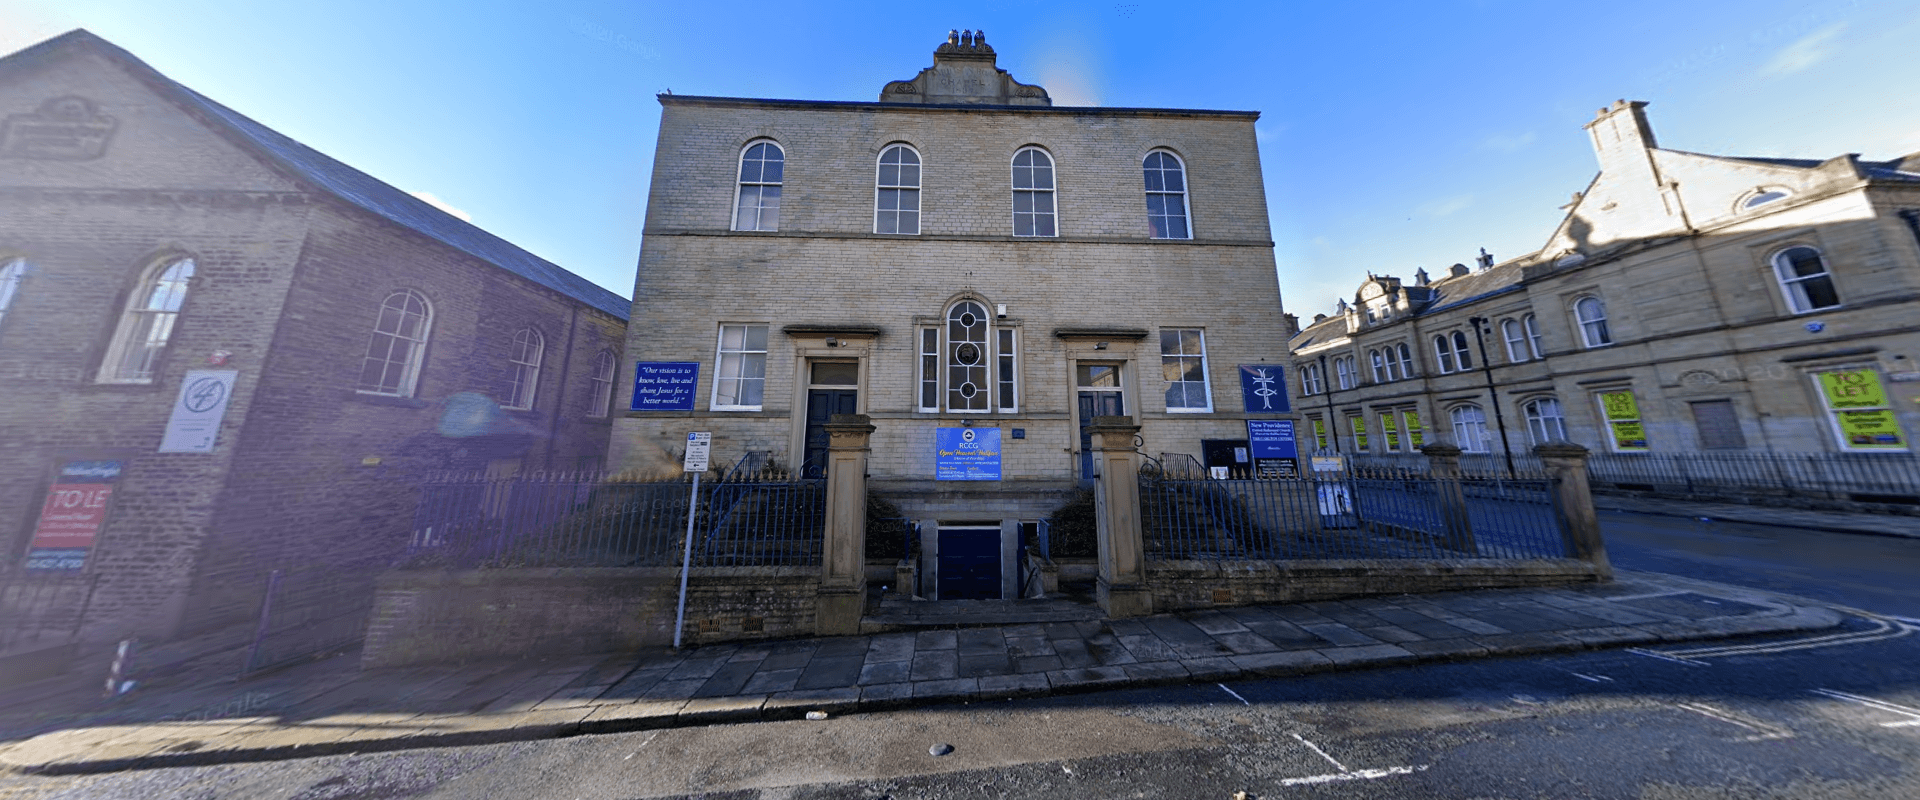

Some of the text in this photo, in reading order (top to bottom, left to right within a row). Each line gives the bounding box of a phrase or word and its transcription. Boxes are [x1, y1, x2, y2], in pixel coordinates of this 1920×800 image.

[941, 79, 986, 87] CHAPEL
[638, 376, 694, 385] know, love, live and
[1828, 371, 1866, 386] TO
[640, 386, 657, 394] share
[653, 386, 673, 397] Jesus
[672, 386, 684, 397] for
[1831, 383, 1871, 399] LET
[643, 396, 662, 404] better
[939, 449, 954, 458] Open
[977, 449, 999, 457] Halifax
[54, 490, 84, 508] TO
